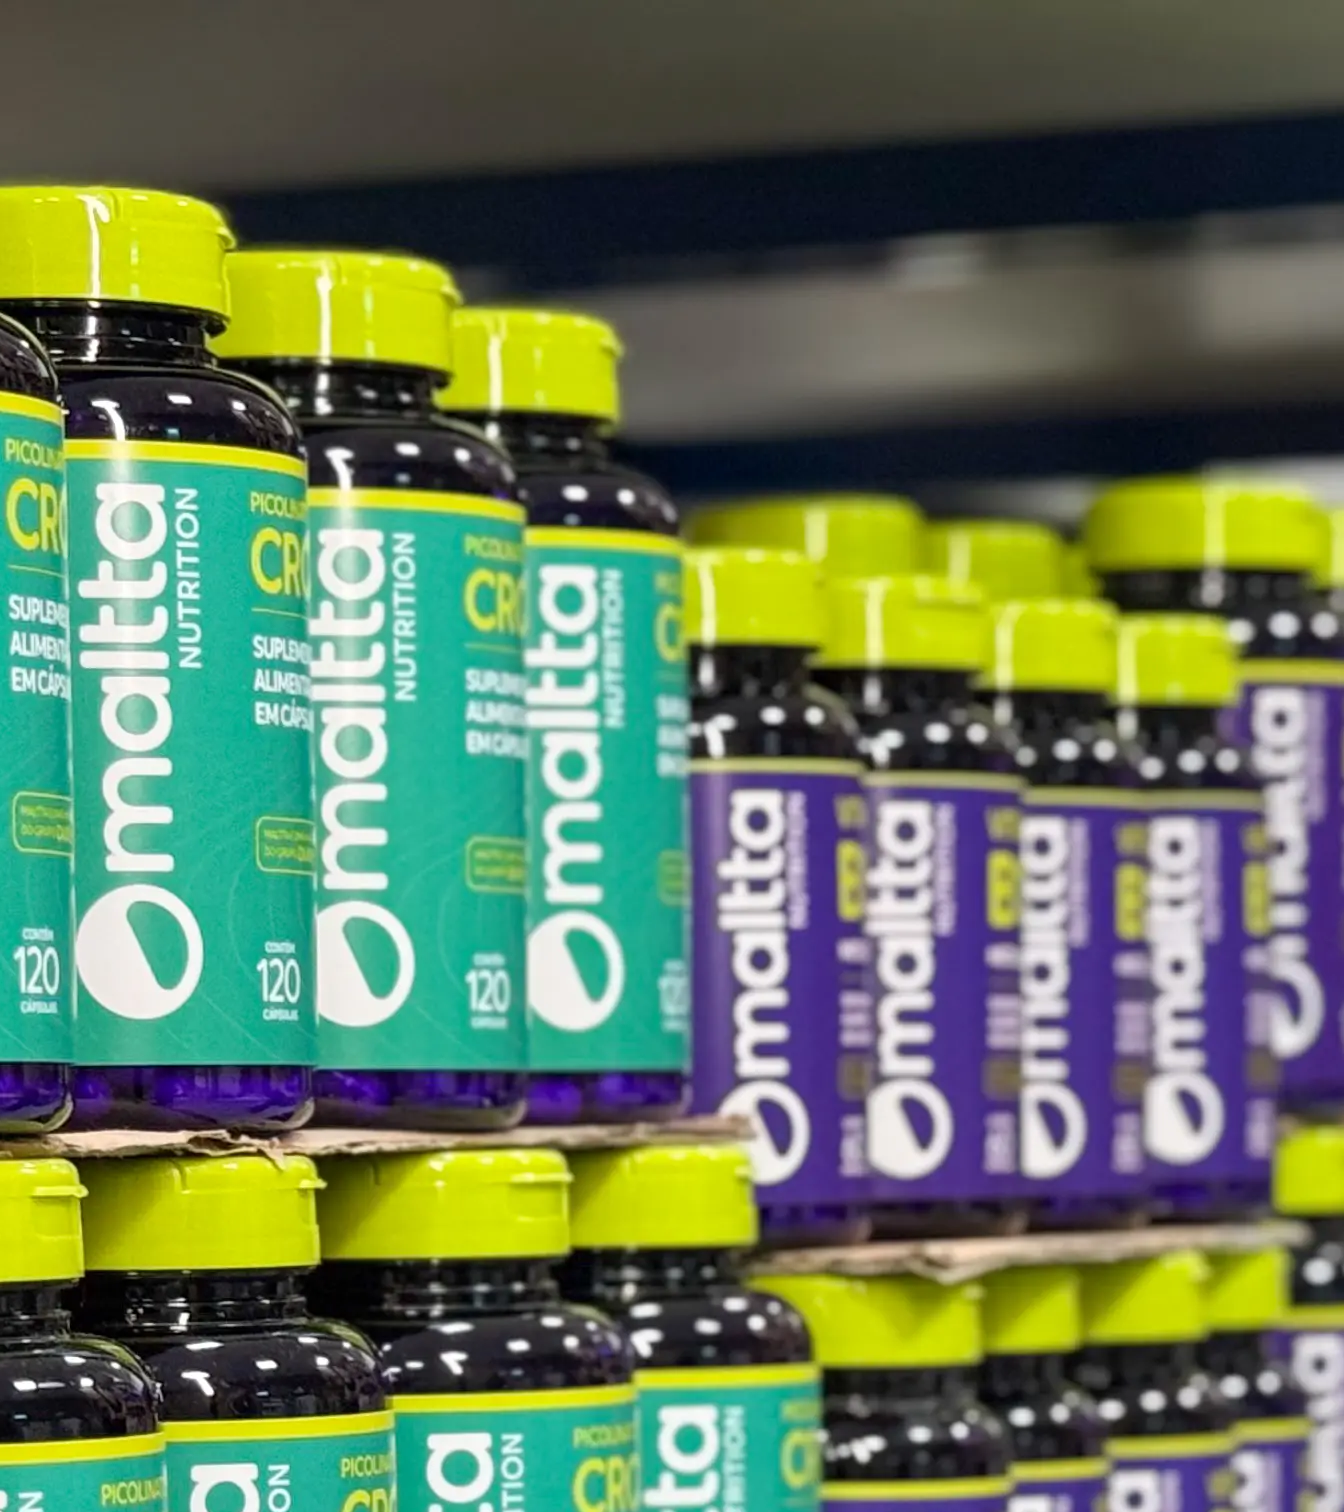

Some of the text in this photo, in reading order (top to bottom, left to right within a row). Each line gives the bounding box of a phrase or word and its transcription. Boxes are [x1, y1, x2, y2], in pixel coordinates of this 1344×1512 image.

[6, 438, 64, 470] PICOLIN
[174, 488, 202, 669] NUTRITION
[394, 532, 416, 701] NUTRITION
[11, 667, 36, 694] EM
[77, 482, 174, 873] maltta
[256, 701, 278, 726] EM
[308, 529, 388, 890] maltta
[525, 564, 602, 904] maltta
[13, 946, 59, 995] 120
[257, 958, 301, 1003] 120
[465, 970, 510, 1012] 120
[717, 789, 791, 1078] maltta
[866, 801, 935, 1077] maltta
